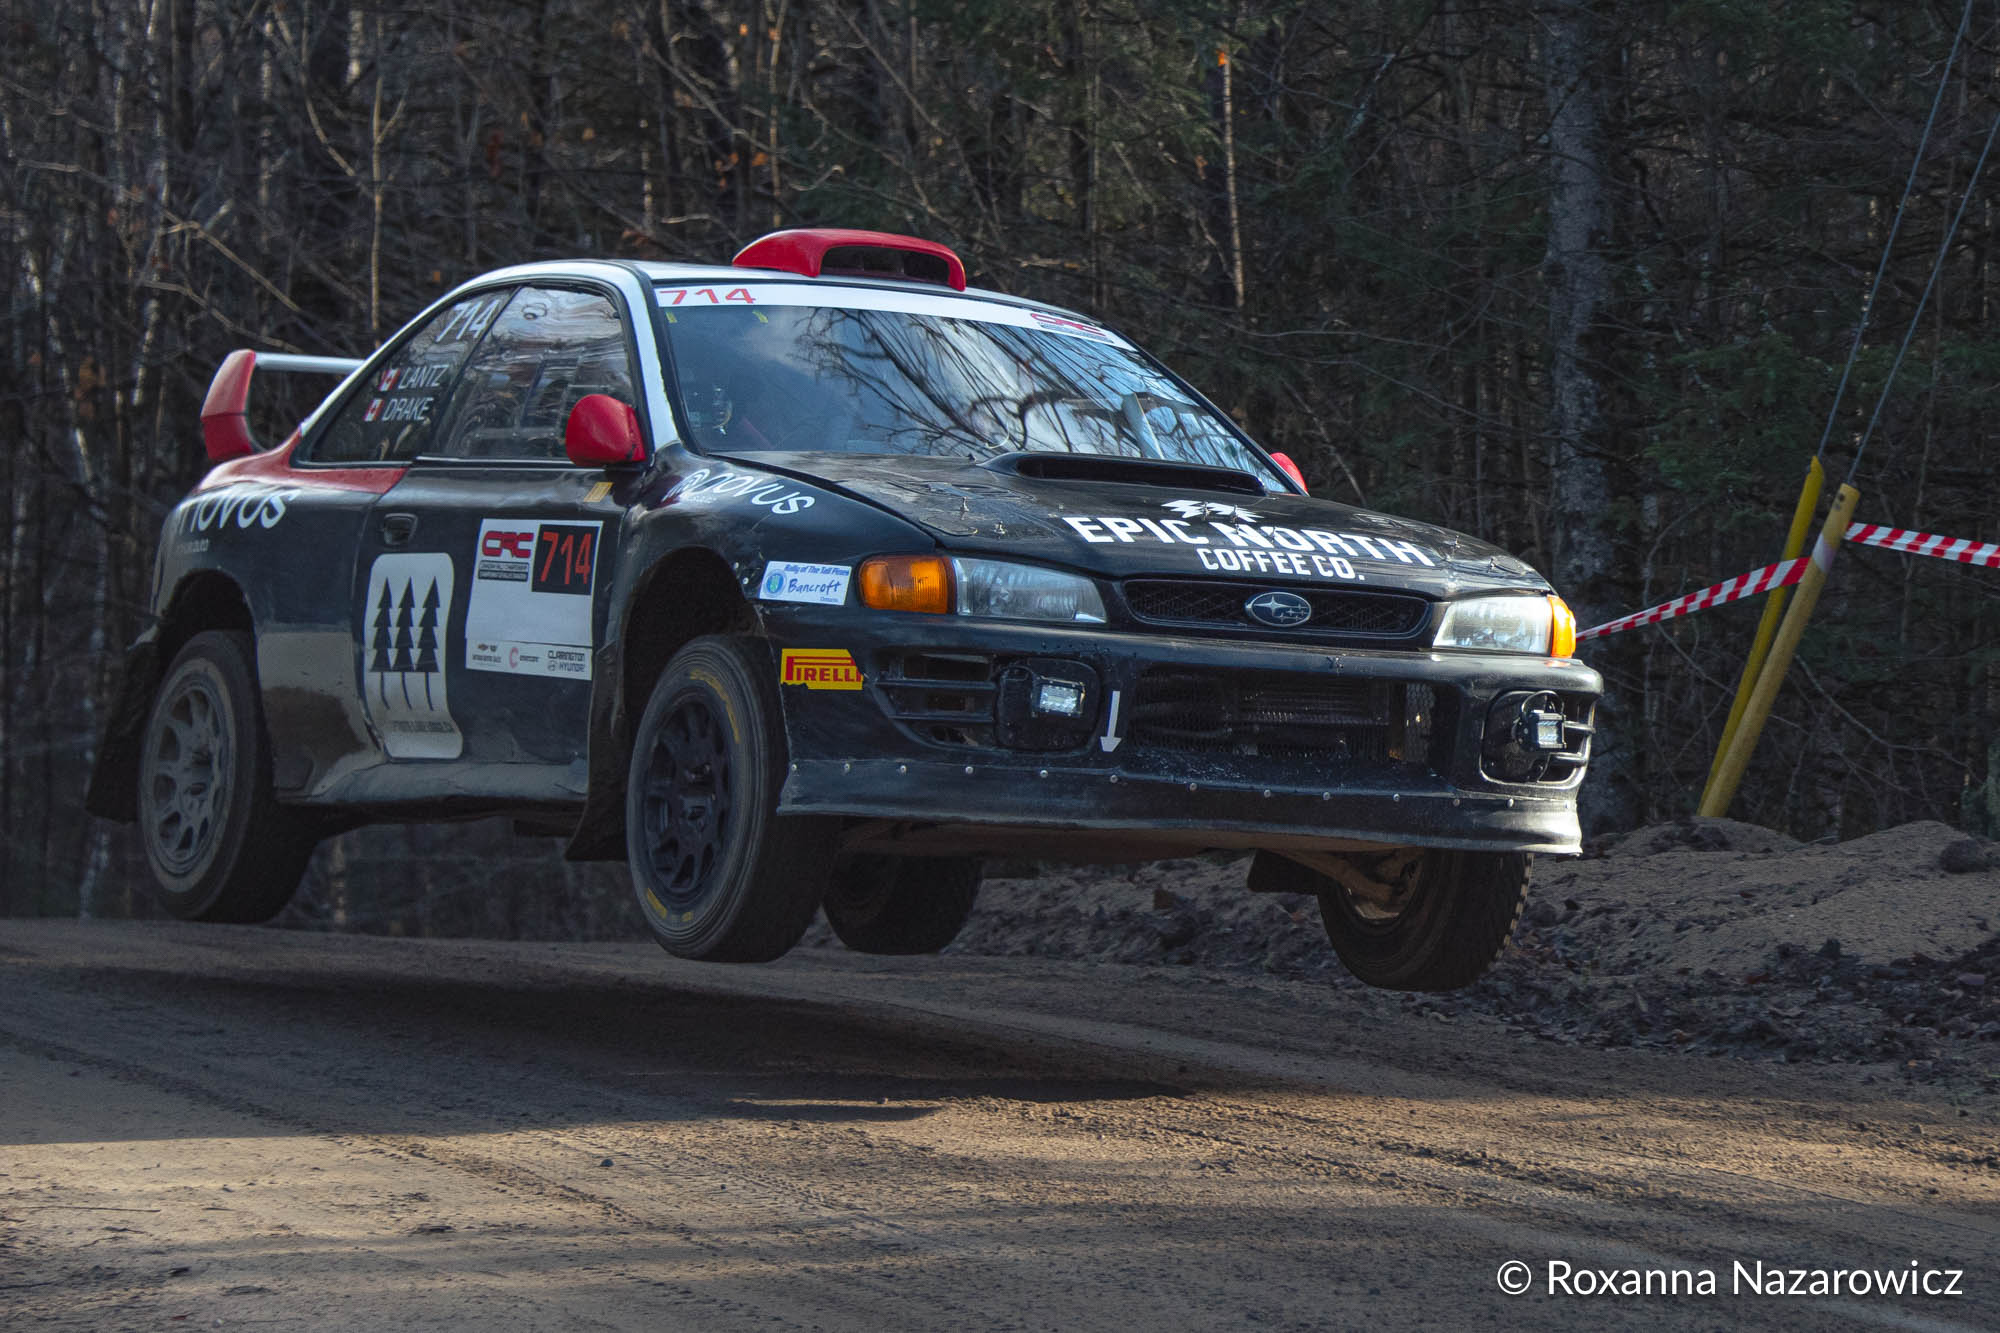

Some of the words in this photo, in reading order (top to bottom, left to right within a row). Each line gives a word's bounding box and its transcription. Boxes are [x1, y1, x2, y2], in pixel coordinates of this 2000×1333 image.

[659, 288, 756, 305] 714
[435, 300, 499, 342] 714
[398, 365, 449, 389] LANTZ
[382, 397, 434, 420] DRAKE
[482, 530, 534, 558] CRC
[1062, 517, 1210, 545] EPIC
[1208, 522, 1436, 567] NORTH
[541, 531, 592, 585] 714
[808, 566, 819, 574] The
[1196, 548, 1311, 575] COFFEE
[1312, 555, 1365, 581] CO.
[788, 578, 842, 595] Bancroft
